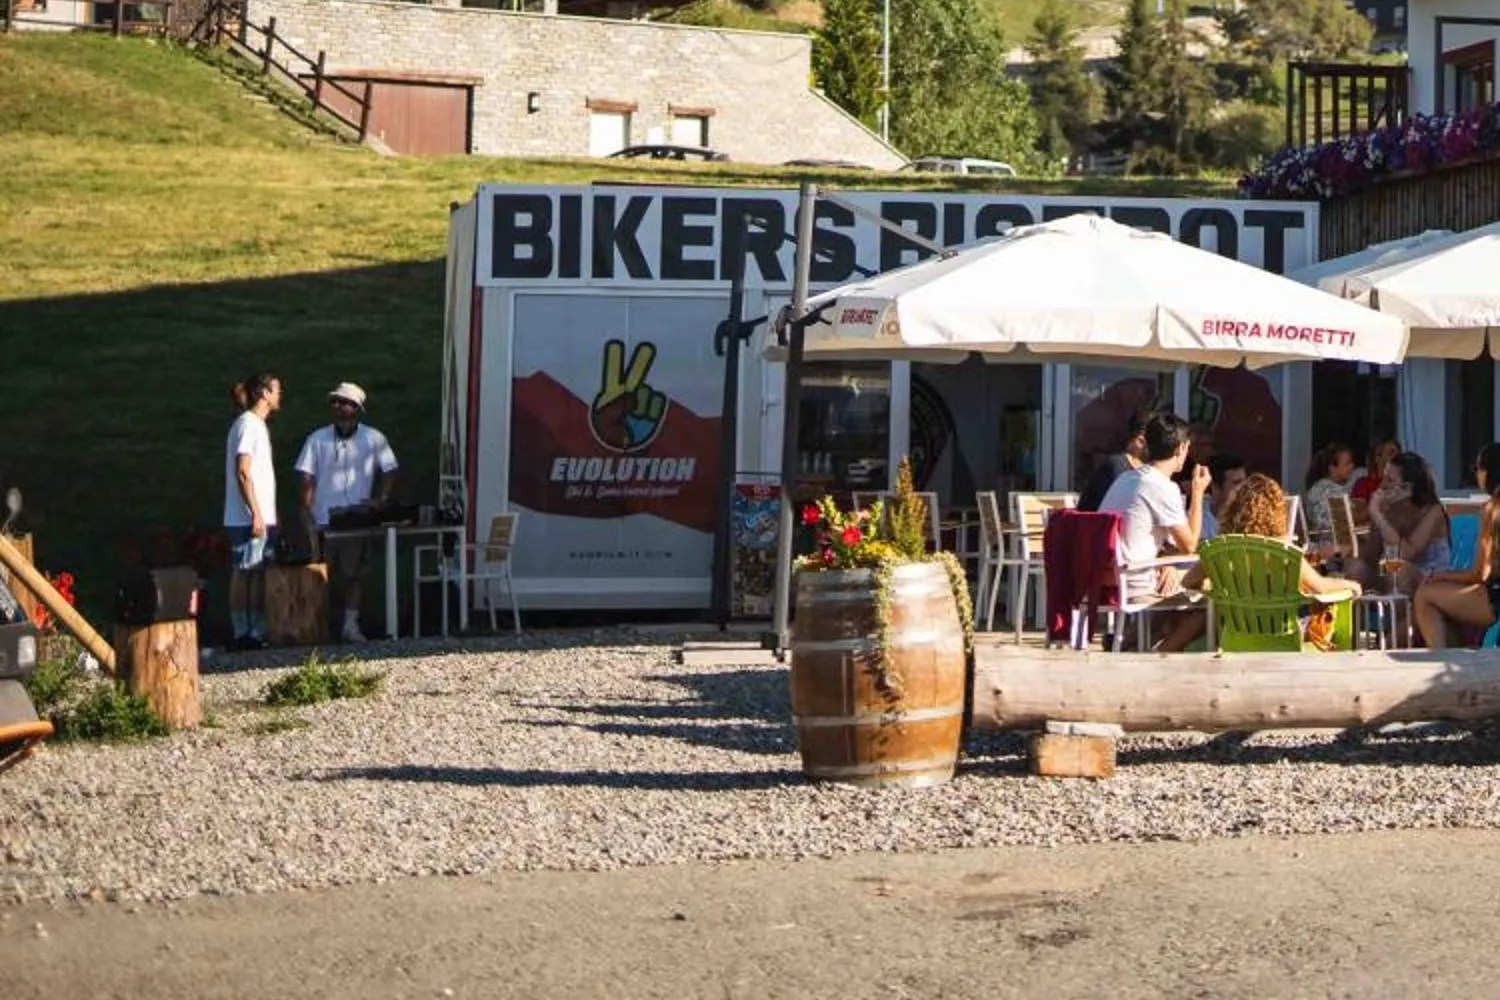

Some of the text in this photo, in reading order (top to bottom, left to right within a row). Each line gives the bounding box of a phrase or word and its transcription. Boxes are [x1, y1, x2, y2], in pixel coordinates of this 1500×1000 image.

[492, 195, 856, 281] BIKERS
[1202, 320, 1356, 347] BIRRA MORETTI
[550, 457, 696, 481] EVOLUTION
